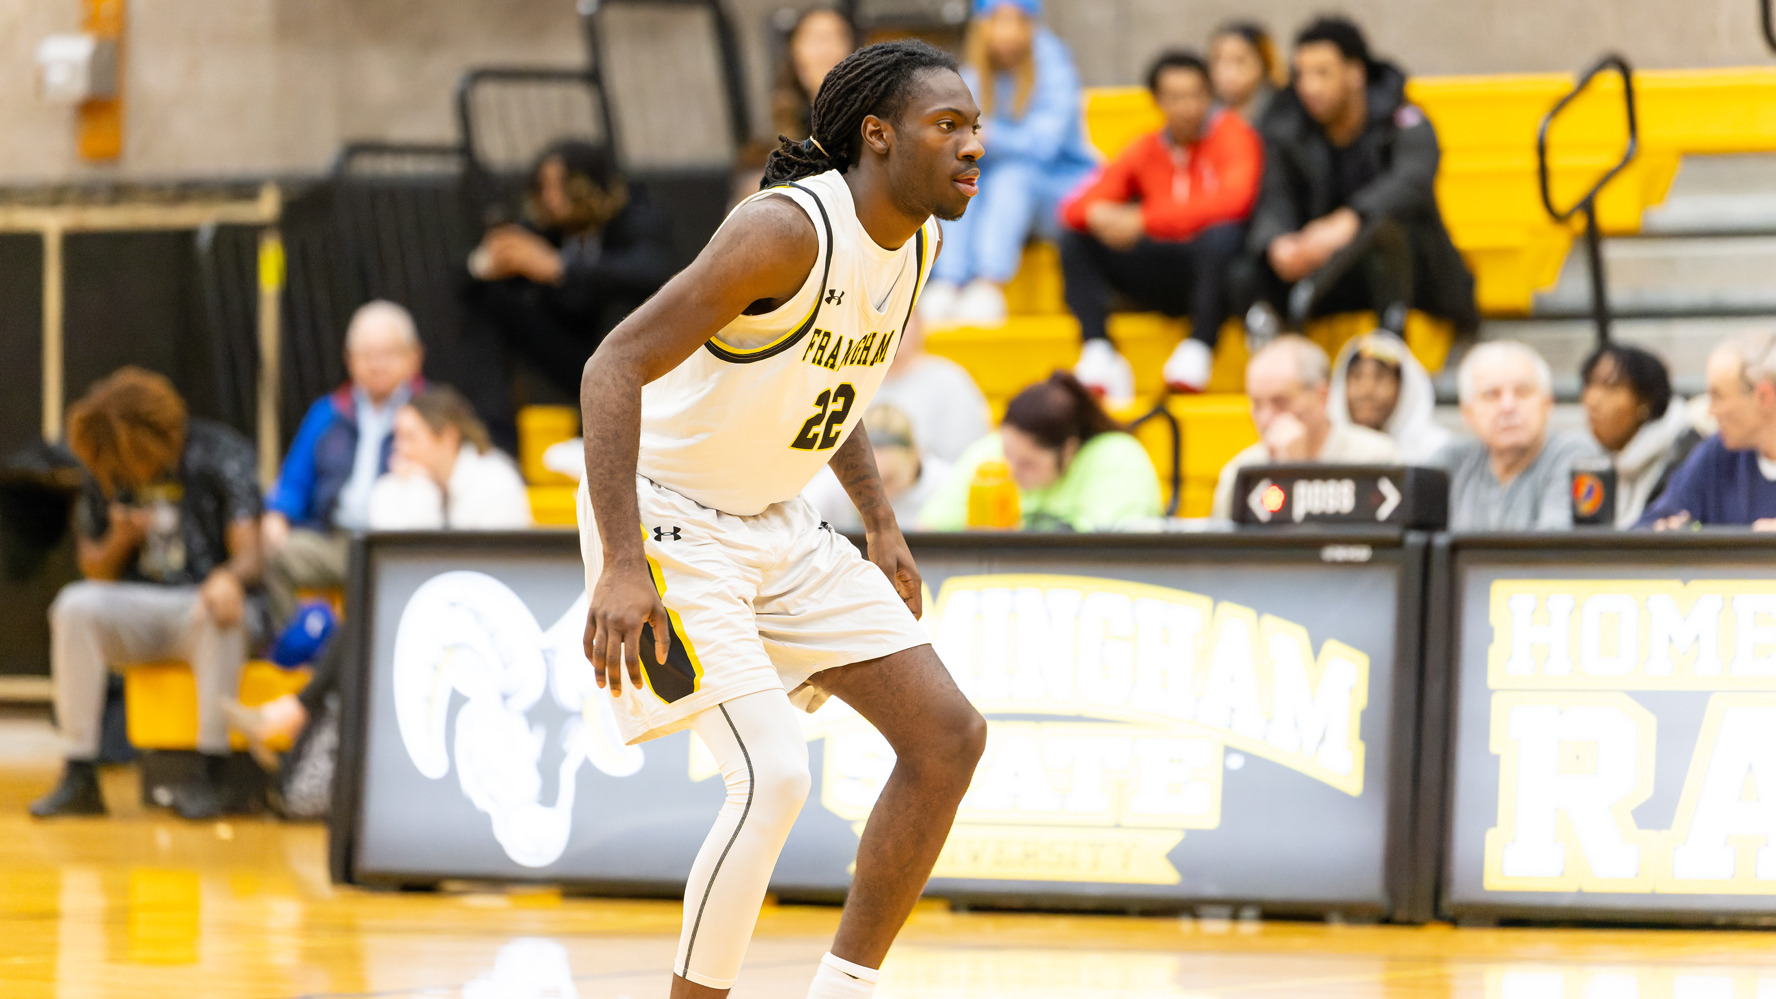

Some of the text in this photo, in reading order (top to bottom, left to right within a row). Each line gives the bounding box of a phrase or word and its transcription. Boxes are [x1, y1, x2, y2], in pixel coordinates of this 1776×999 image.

[789, 382, 857, 451] 22
[1497, 586, 1776, 683] HOME
[828, 728, 1217, 822] SATE
[946, 837, 1139, 870] IVERSITY
